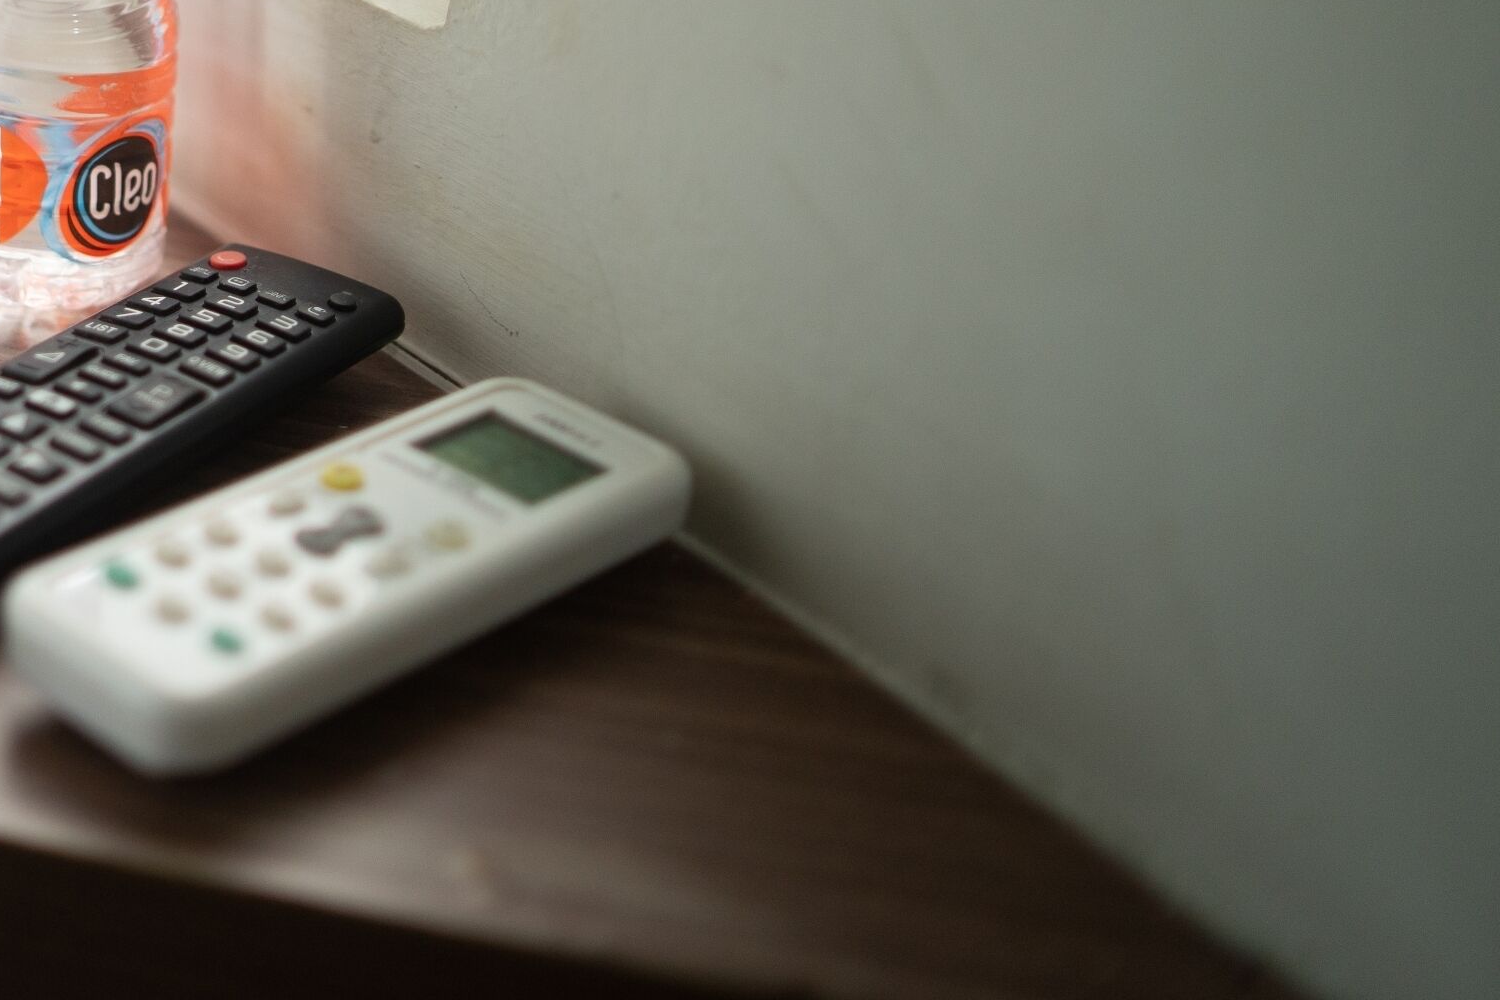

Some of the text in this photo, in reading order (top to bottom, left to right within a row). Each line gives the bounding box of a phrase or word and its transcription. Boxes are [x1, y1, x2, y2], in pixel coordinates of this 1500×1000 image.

[89, 161, 158, 220] Cleo
[173, 281, 189, 291] 1
[141, 296, 167, 306] 4
[217, 295, 245, 309] 2
[116, 307, 143, 318] 7
[191, 309, 221, 322] 5
[85, 321, 119, 334] LIST
[270, 315, 298, 330] 3
[167, 323, 194, 337] 8
[246, 329, 275, 345] 6
[140, 337, 169, 351] 0
[220, 344, 249, 360] 9
